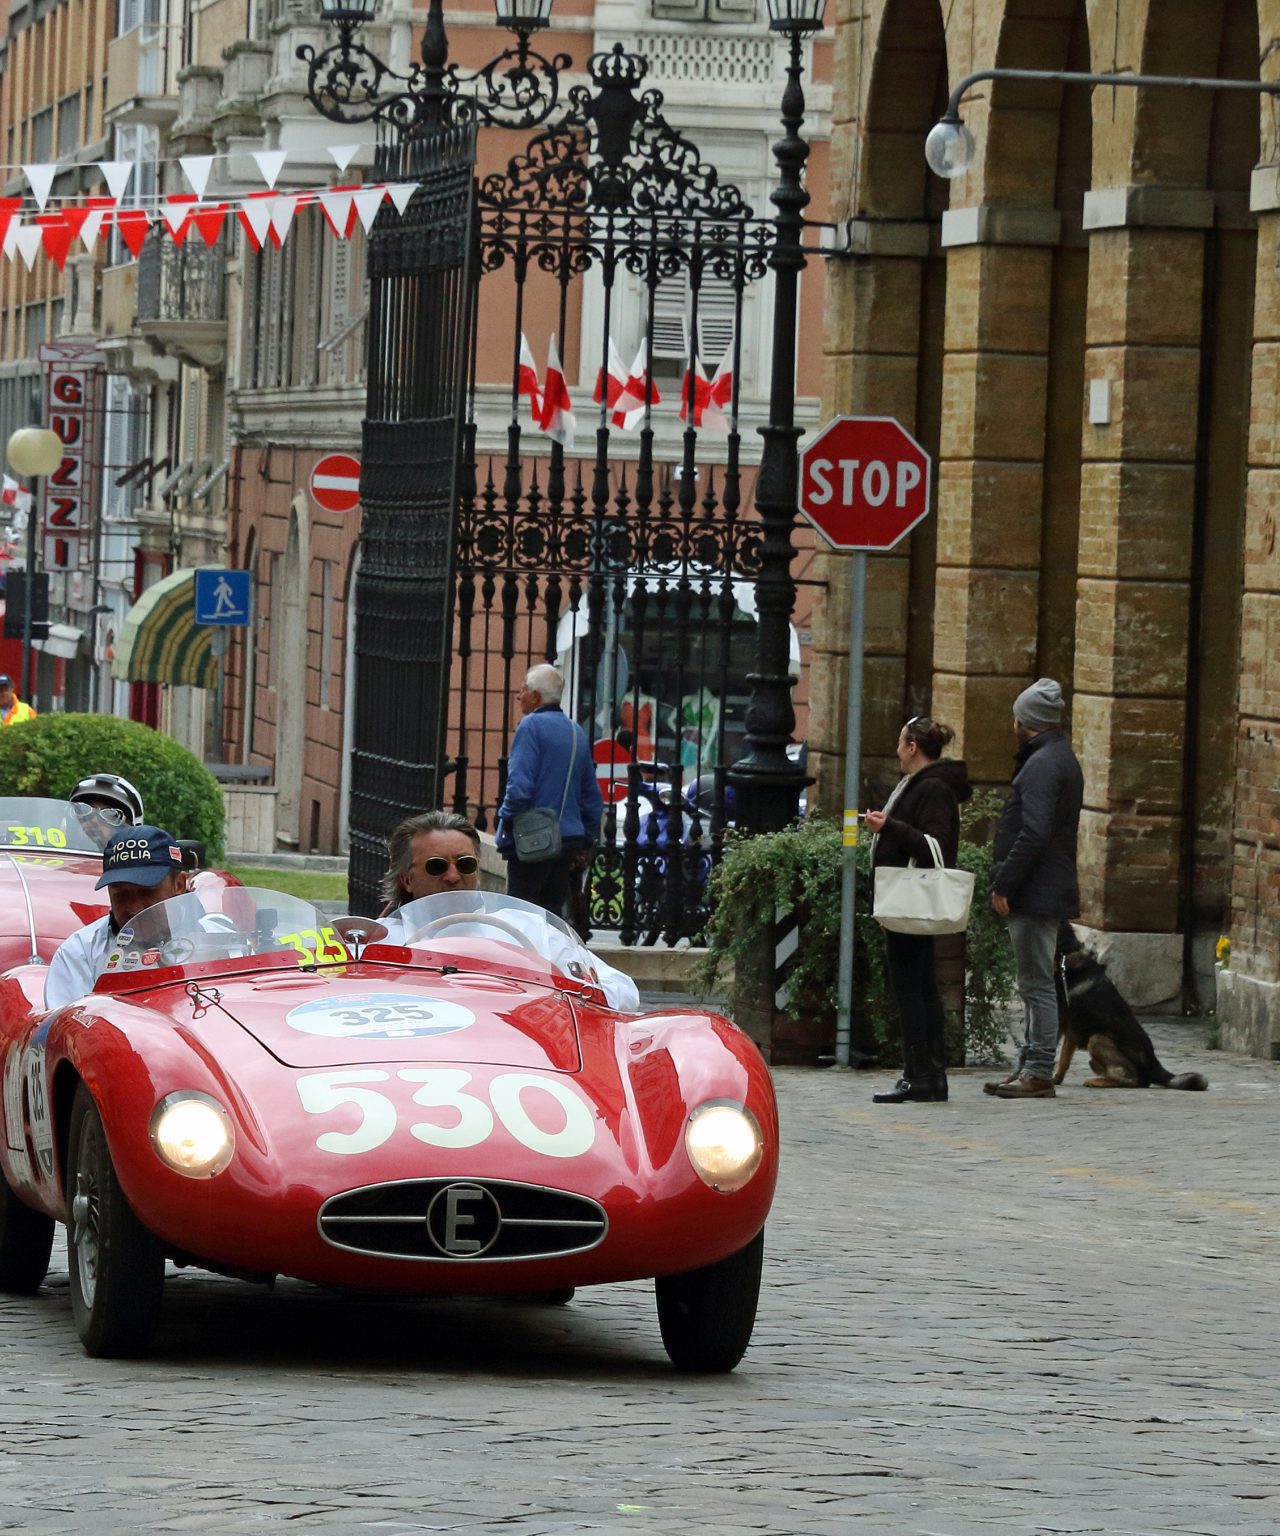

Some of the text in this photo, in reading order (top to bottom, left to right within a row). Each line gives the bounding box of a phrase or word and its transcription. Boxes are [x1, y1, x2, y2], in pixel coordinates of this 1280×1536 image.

[50, 375, 82, 567] GUZZI
[808, 458, 921, 507] STOP
[7, 826, 67, 848] 310
[112, 839, 149, 853] 1000
[277, 927, 348, 967] 325
[329, 1005, 434, 1027] 325
[295, 1068, 596, 1158] 530
[444, 1188, 484, 1251] E
